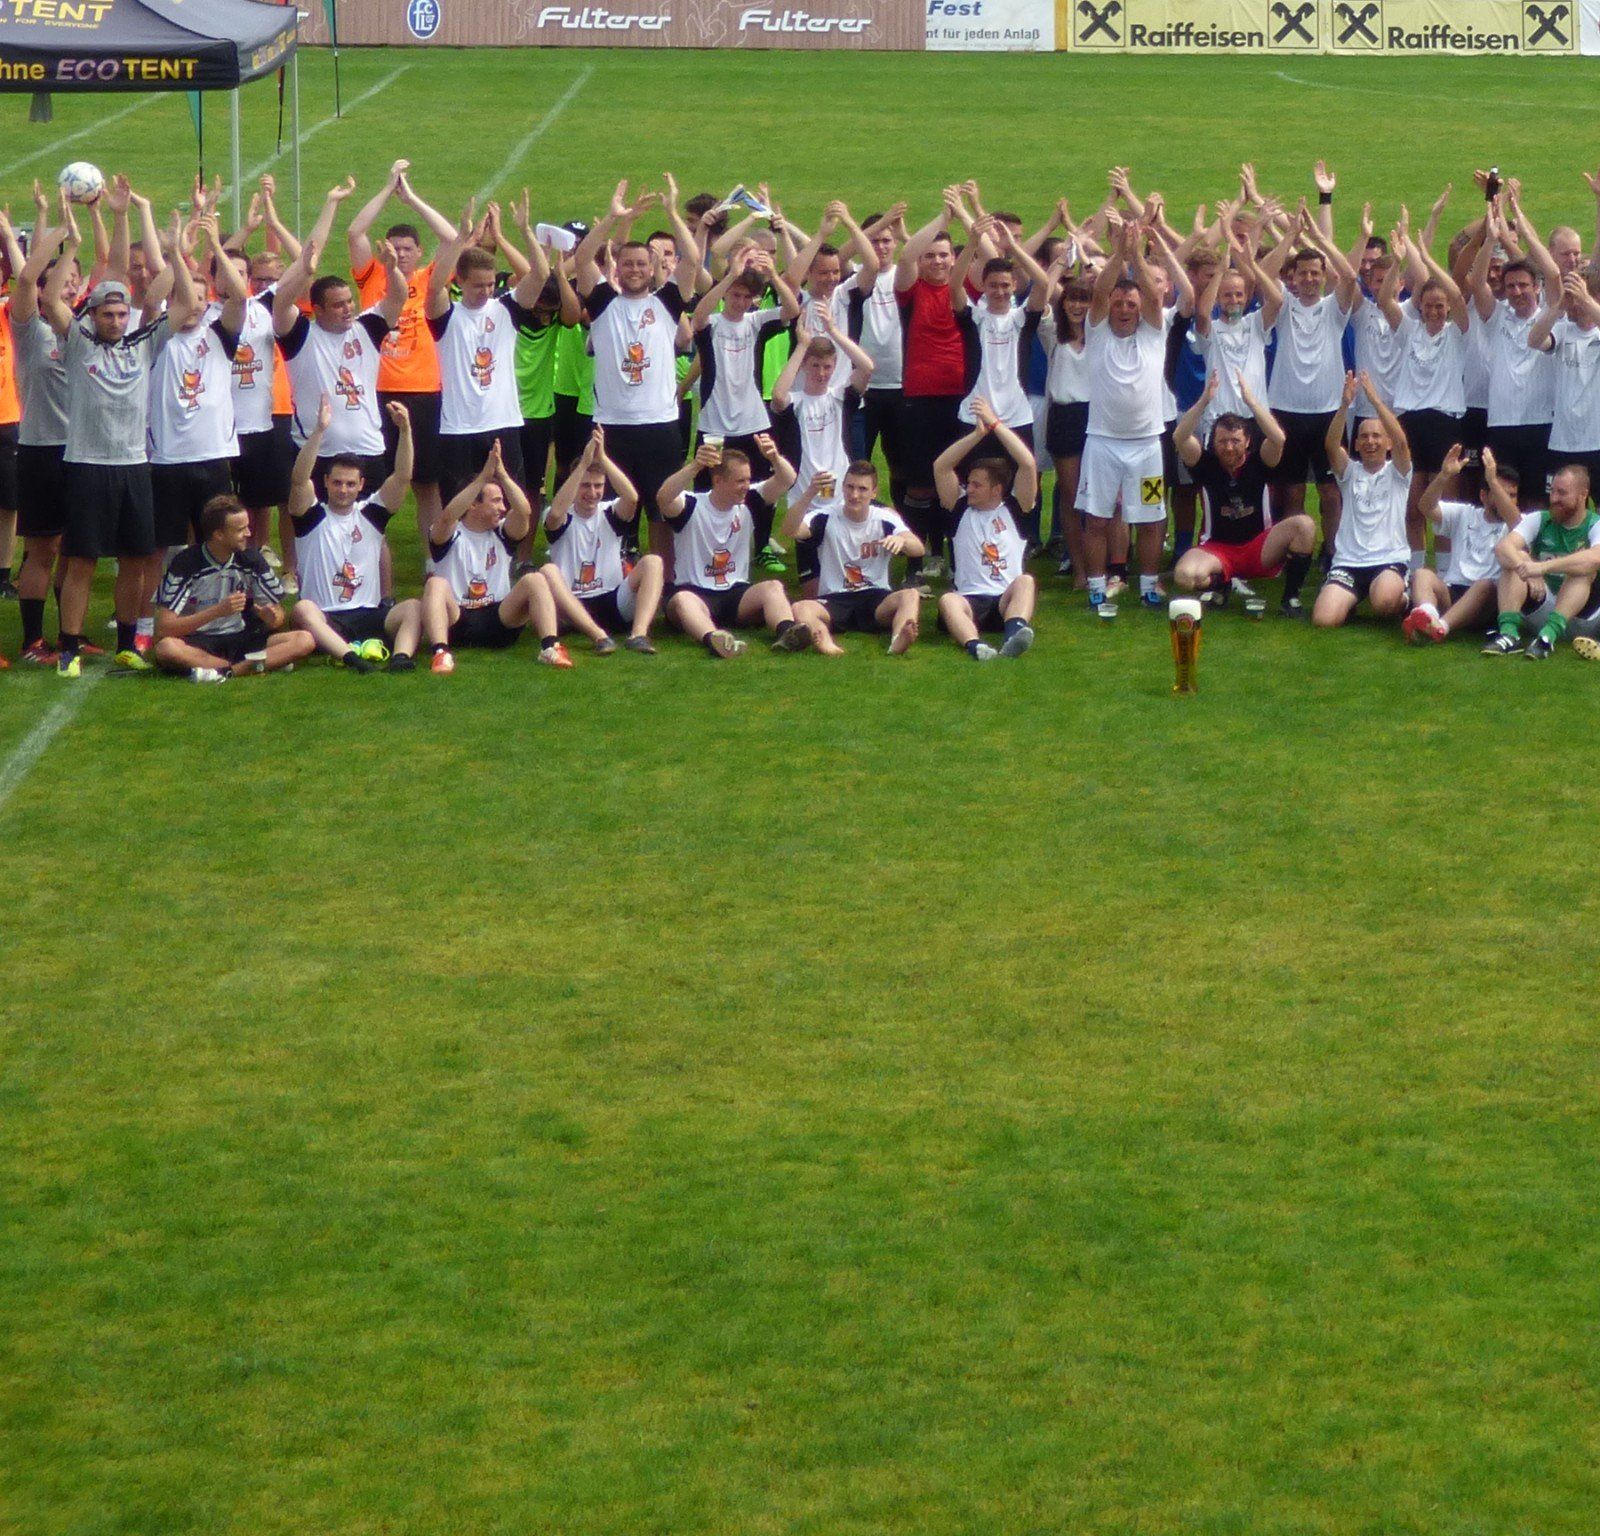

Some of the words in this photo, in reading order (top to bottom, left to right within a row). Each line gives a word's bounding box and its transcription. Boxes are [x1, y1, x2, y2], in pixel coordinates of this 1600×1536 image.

[537, 6, 671, 31] Fulterer
[738, 8, 871, 33] Fulterer
[927, 0, 982, 16] Fest
[943, 27, 961, 39] für
[964, 28, 1000, 41] jeden
[1003, 27, 1040, 40] Anlaß
[1129, 22, 1264, 49] Raiffeisen
[1387, 24, 1520, 50] Raiffeisen
[55, 58, 199, 81] ECOTENT
